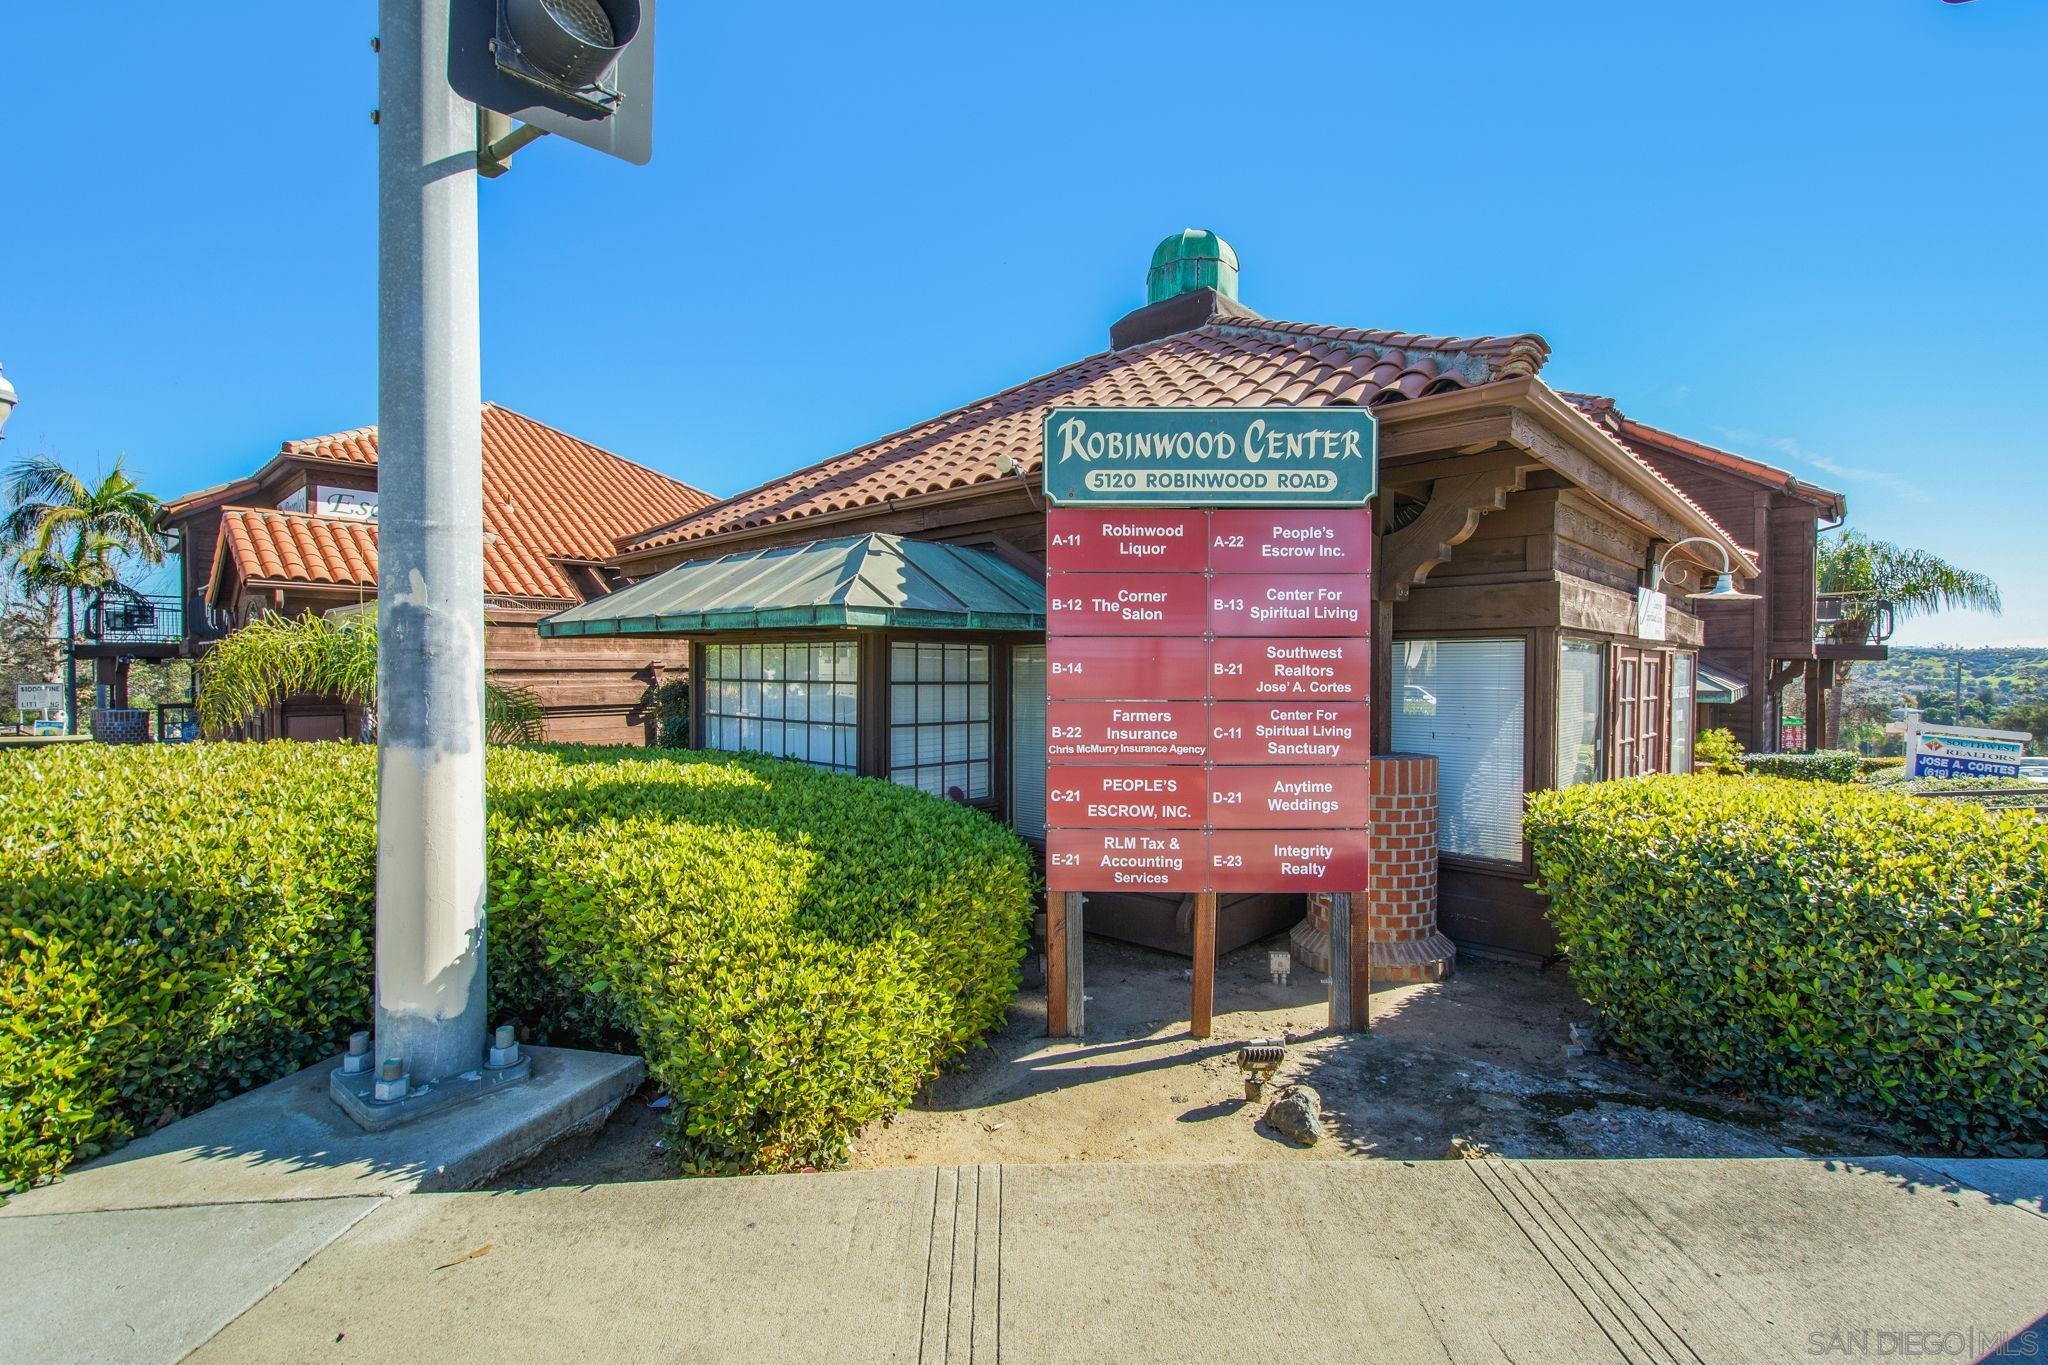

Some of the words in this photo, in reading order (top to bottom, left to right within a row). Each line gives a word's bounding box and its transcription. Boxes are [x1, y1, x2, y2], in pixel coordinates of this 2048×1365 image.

[1094, 473, 1137, 488] 5120
[1146, 473, 1268, 488] ROBINWOOD
[1277, 473, 1329, 488] ROAD
[1102, 523, 1184, 537] Robinwood
[1273, 526, 1335, 541] People's
[1052, 534, 1081, 546] A-11
[1214, 535, 1245, 548] A-22
[1119, 542, 1167, 557] Liquor
[1262, 544, 1316, 557] Escrow
[1319, 544, 1345, 557] Inc.
[1117, 590, 1168, 603] Corner
[1266, 588, 1315, 601] Center
[1319, 588, 1343, 601] For
[1052, 599, 1082, 611] B-12
[1091, 598, 1120, 612] The
[1214, 599, 1244, 611] B-13
[1122, 607, 1163, 621] Salon
[1250, 606, 1310, 622] Spiritual
[1314, 606, 1358, 622] Living
[1266, 645, 1343, 659] Southwest
[1052, 663, 1083, 674] B-14
[1214, 663, 1243, 675] B-21
[1274, 664, 1334, 677] Realtors
[1292, 681, 1306, 693] A.
[1309, 681, 1352, 693] Cortes
[1112, 709, 1172, 722] Farmers
[1270, 709, 1313, 721] Center
[1316, 709, 1338, 721] For
[1052, 727, 1082, 738] B-22
[1107, 728, 1178, 740] Insurance
[1213, 727, 1242, 739] C-11
[1255, 725, 1309, 739] Spiritual
[1313, 725, 1352, 739] Living
[1048, 745, 1075, 754] Chris
[1076, 744, 1119, 755] McMurry
[1120, 743, 1168, 753] Insurance
[1168, 744, 1207, 755] Agency
[1267, 742, 1340, 757] Sanctuary
[1946, 739, 2017, 752] SOUTHWEST
[1946, 749, 2016, 761] REALTORS
[1919, 756, 1949, 768] JOSE
[1952, 760, 1964, 770] A.
[1967, 761, 2016, 775] CORTES
[1103, 778, 1177, 792] PEOPLE'S
[1273, 780, 1333, 796] Anytime
[1050, 790, 1080, 802] C-21
[1213, 792, 1242, 804] D-21
[1087, 804, 1158, 819] ESCROW,
[1162, 805, 1191, 818] INC.
[1267, 798, 1339, 814] Weddings
[1104, 837, 1136, 850] RLM
[1140, 837, 1165, 850] Tax
[1169, 837, 1180, 850] &
[1274, 844, 1333, 860] Integrity
[1052, 854, 1080, 865] E-21
[1100, 854, 1183, 870] Accounting
[1213, 856, 1243, 867] E-23
[1281, 862, 1326, 878] Realty
[1114, 871, 1169, 884] Services
